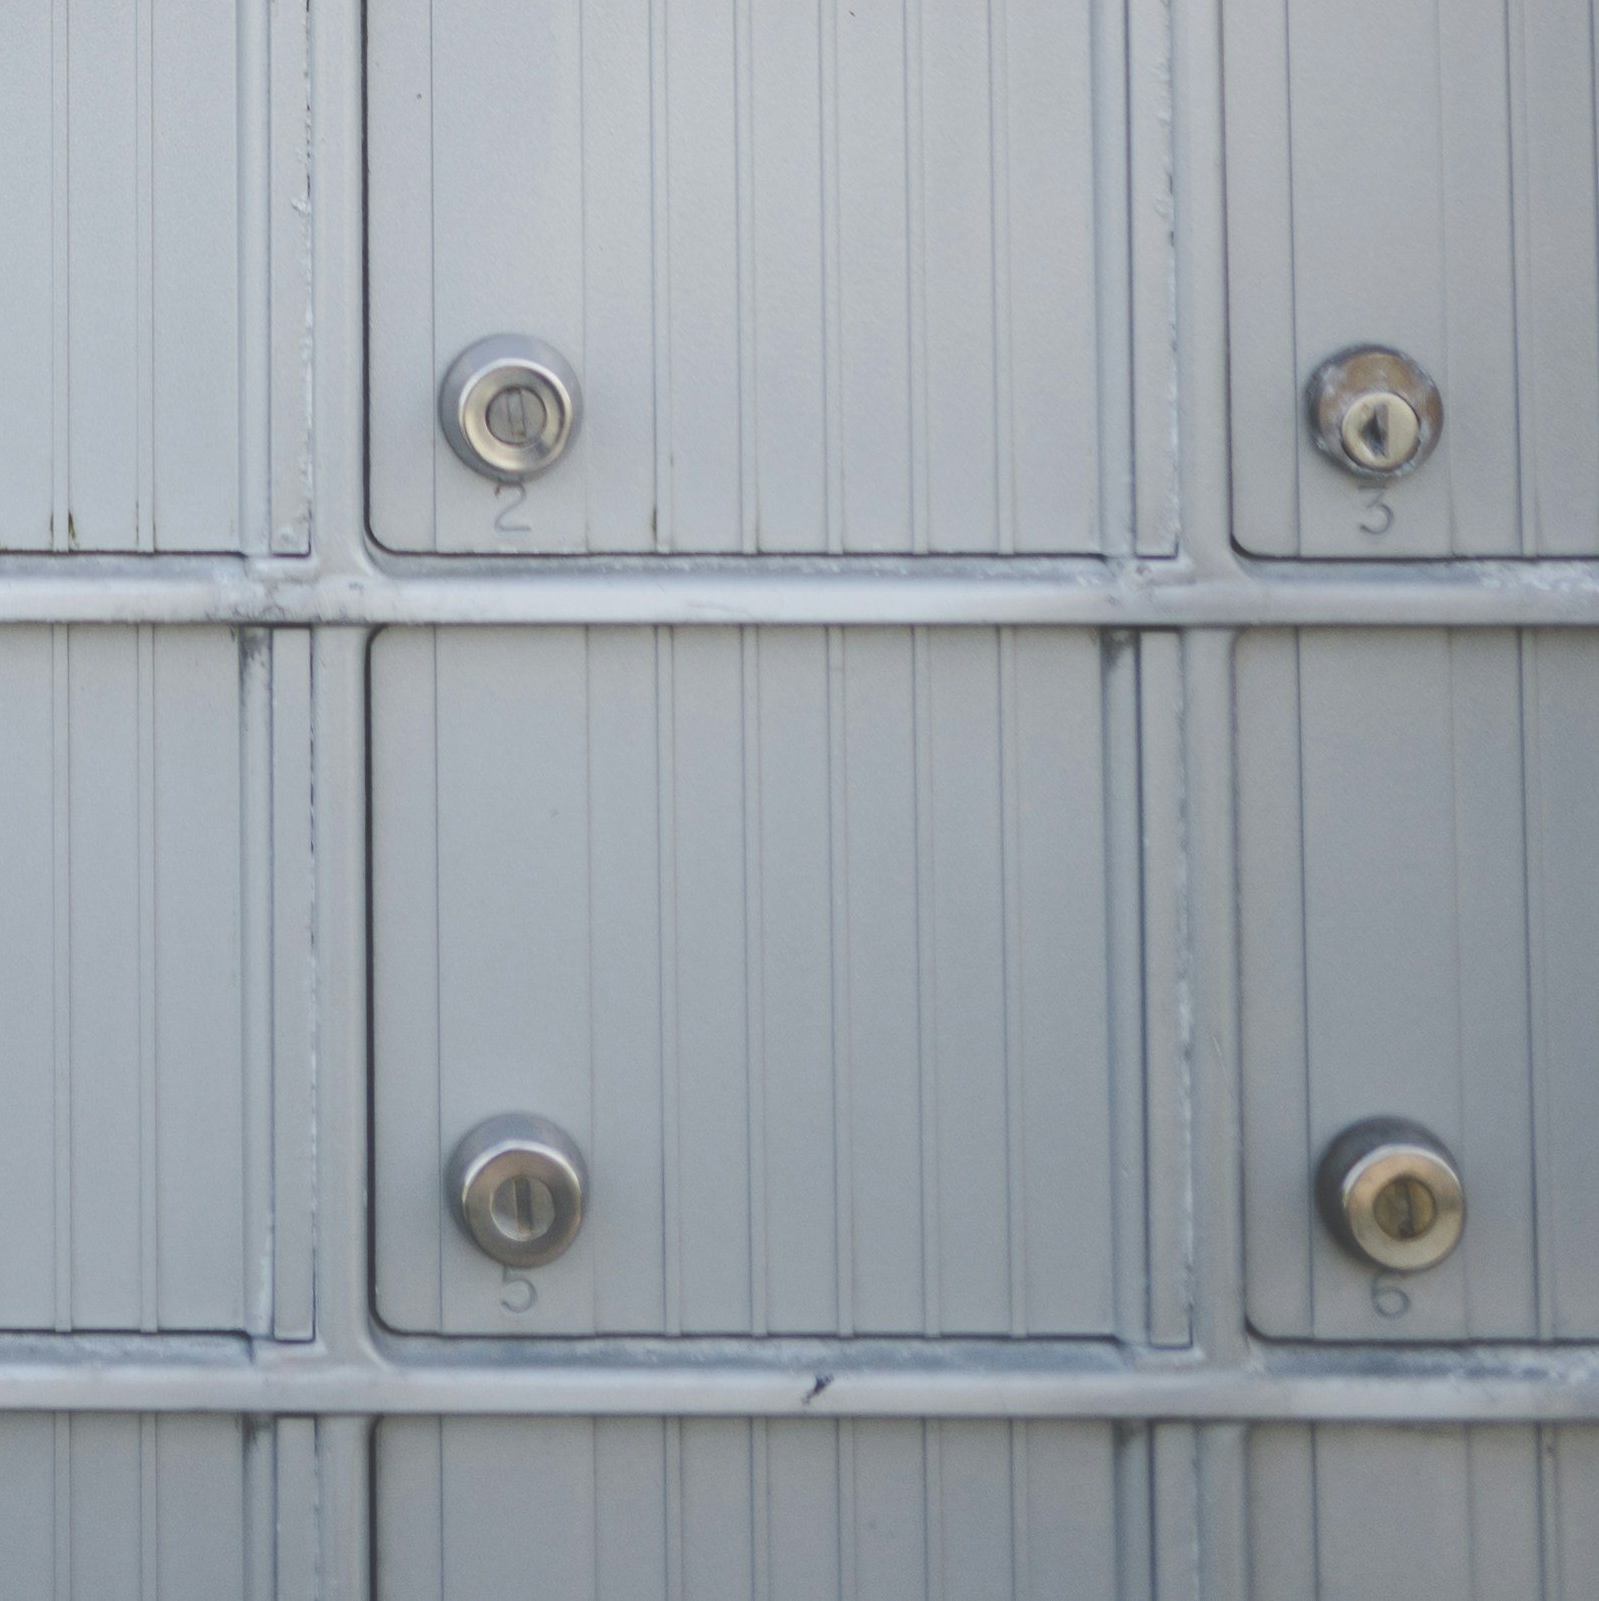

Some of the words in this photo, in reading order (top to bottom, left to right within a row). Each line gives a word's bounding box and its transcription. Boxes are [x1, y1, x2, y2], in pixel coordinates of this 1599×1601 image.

[494, 481, 531, 531] 2
[1357, 482, 1394, 535] 3
[501, 1265, 537, 1313] 5
[1371, 1270, 1411, 1319] 6
